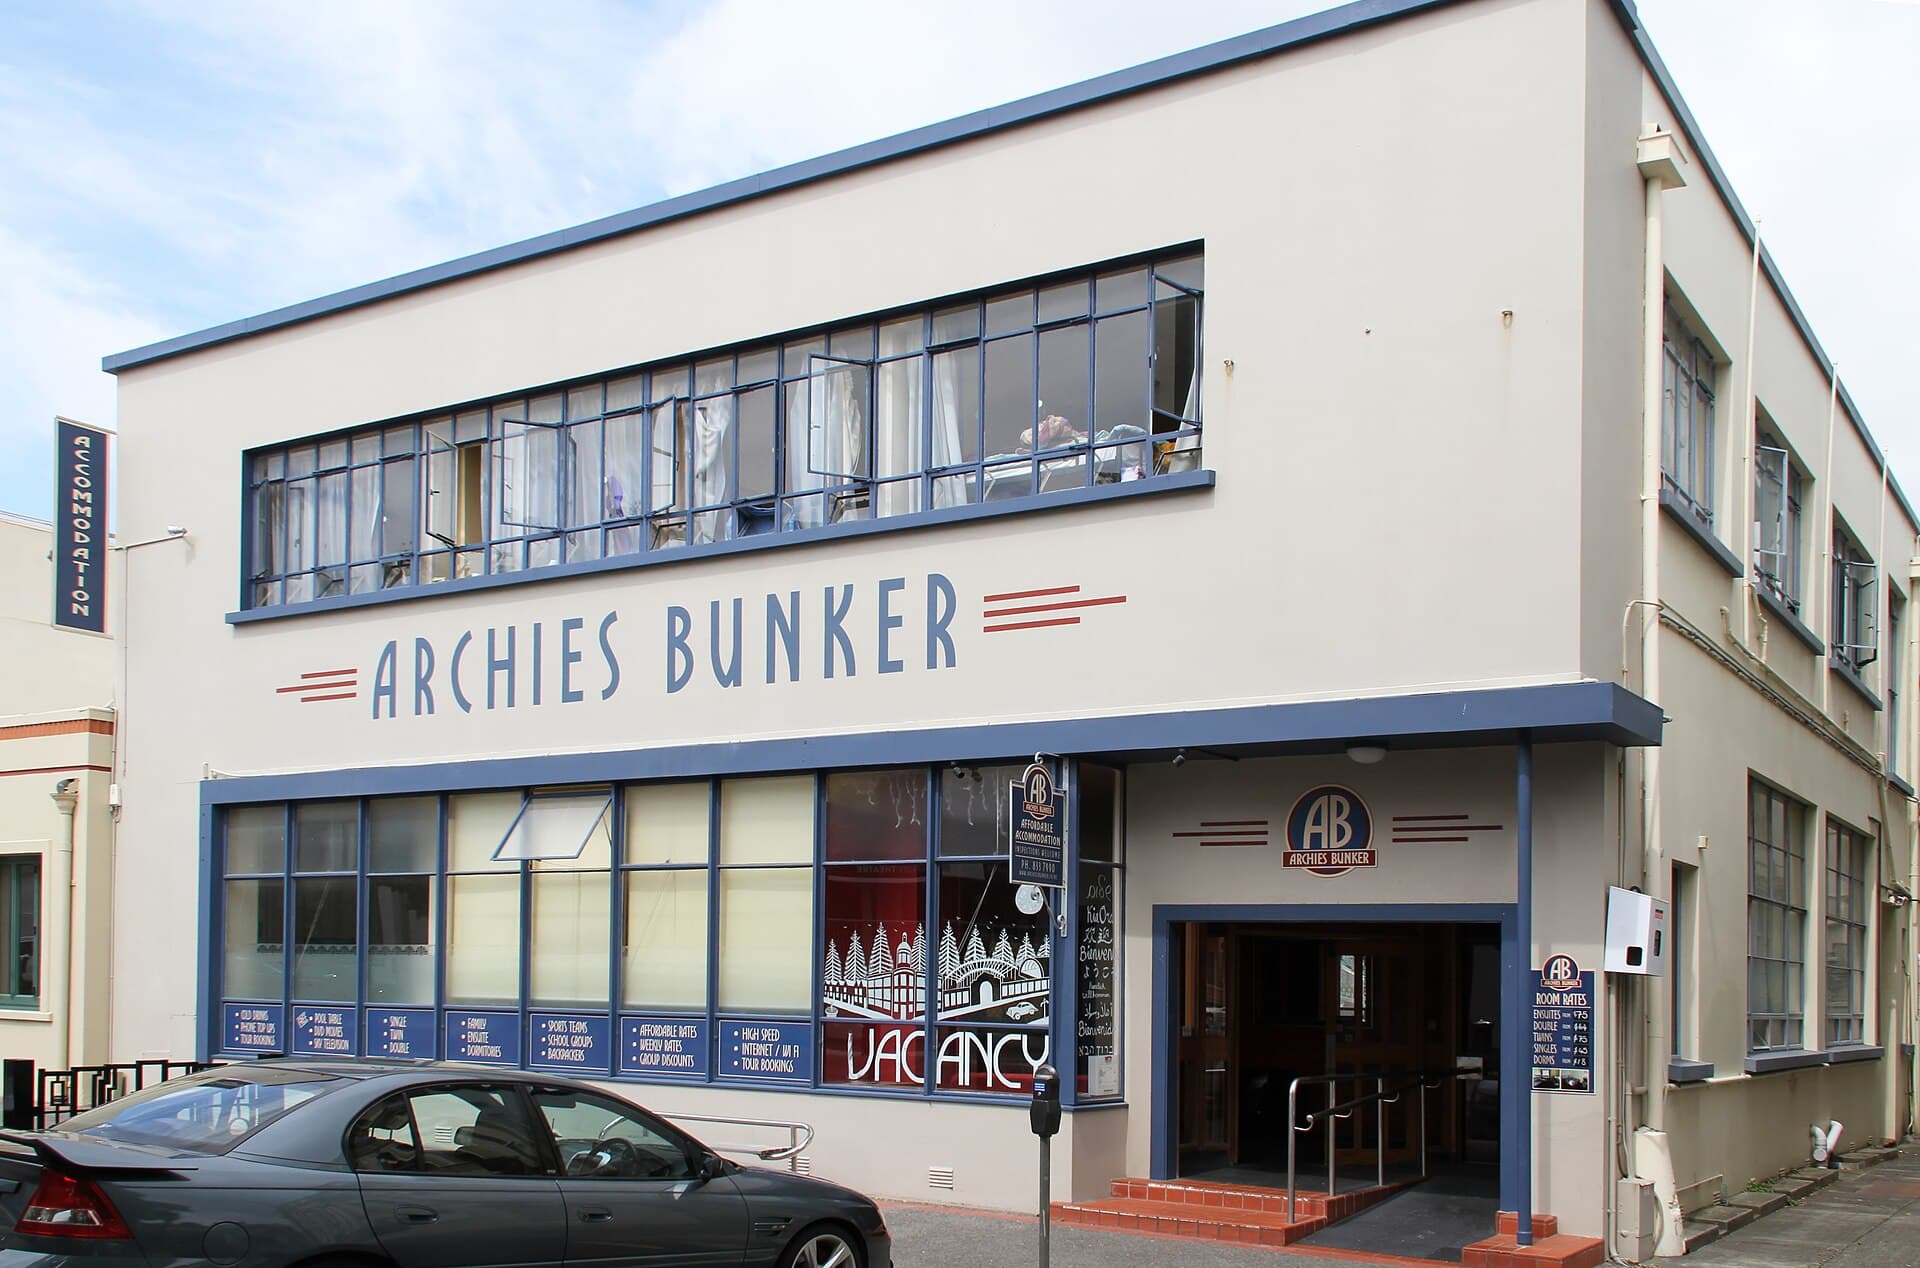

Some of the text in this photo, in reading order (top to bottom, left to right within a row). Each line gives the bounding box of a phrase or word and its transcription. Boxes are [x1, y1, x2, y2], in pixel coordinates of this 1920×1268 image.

[72, 436, 92, 617] ACCOMMODATION
[372, 573, 957, 719] ARCHIES BUNKER
[1030, 773, 1047, 804] AB
[1020, 818, 1054, 833] AFFORDABLE
[1302, 794, 1352, 849] AB
[1015, 830, 1061, 846] ACCOMMODATION
[1289, 852, 1369, 865] ARCHIES BUNKER
[1549, 958, 1571, 980] AB
[1536, 992, 1587, 1006] ROOM RATES
[240, 1009, 269, 1021] COLD DRINKS
[314, 1012, 327, 1024] POOL
[327, 1013, 343, 1024] TABLE
[1533, 1009, 1561, 1020] ENSUITES
[240, 1022, 276, 1034] PHONE TOP UPS
[389, 1016, 407, 1028] SINGLE
[467, 1018, 487, 1030] FAMILY
[547, 1020, 588, 1034] SPORTS TEAMS
[1533, 1021, 1558, 1031] DOUBLE
[325, 1026, 343, 1038] MOVIES
[389, 1029, 404, 1041] TWIN
[467, 1031, 489, 1044] ENSUITE
[639, 1024, 697, 1039] AFFORDABLE RATES
[742, 1027, 780, 1042] HIGH SPEED
[1532, 1032, 1553, 1042] TWINS
[240, 1033, 276, 1046] TOUR BOOKINGS
[313, 1038, 350, 1051] SKY TELEVISION
[547, 1034, 593, 1049] SCHOOL GROUPS
[639, 1039, 683, 1053] WEEKLY RATES
[389, 1042, 410, 1054] DOUBLE
[467, 1044, 502, 1057] DORMITORIES
[742, 1043, 773, 1057] INTERNET
[782, 1045, 791, 1058] WI
[1533, 1044, 1557, 1054] SINGLES
[547, 1048, 585, 1062] BACKPACKERS
[639, 1054, 695, 1069] GROUP DISCOUNTS
[848, 1028, 1049, 1088] VACANCY
[1533, 1055, 1555, 1065] DORMS
[742, 1057, 794, 1073] TOUR BOOKINGS
